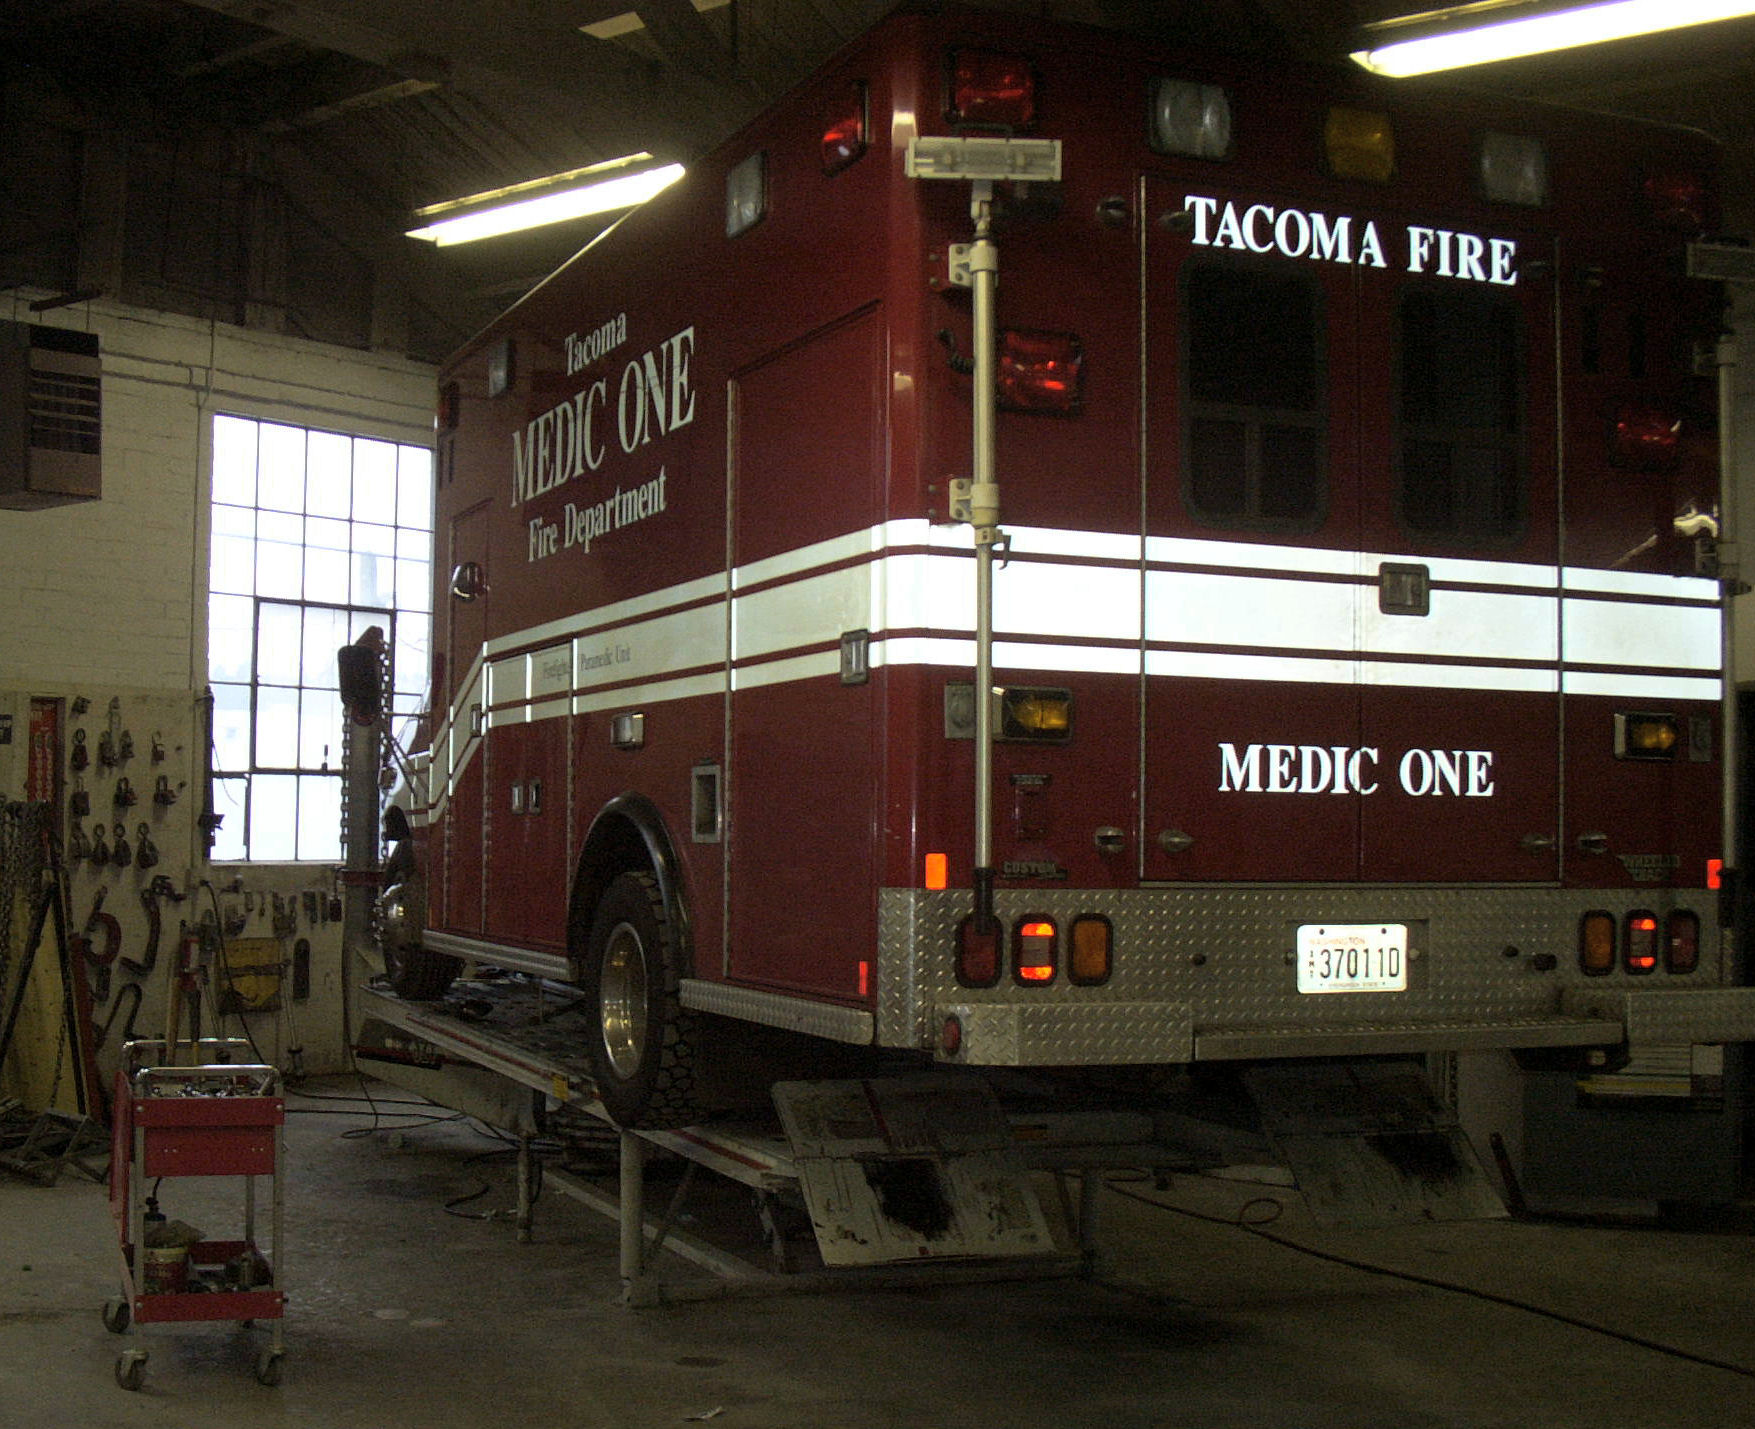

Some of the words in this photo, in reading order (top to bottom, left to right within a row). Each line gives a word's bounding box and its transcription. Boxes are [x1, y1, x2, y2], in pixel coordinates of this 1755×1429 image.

[1184, 195, 1387, 268] TACOMA
[1406, 225, 1518, 286] FIRE
[564, 312, 627, 376] Tacoma
[511, 377, 607, 508] MEDIC
[618, 326, 695, 453] ONE
[528, 516, 558, 562] Fire
[564, 464, 667, 554] Department
[1217, 743, 1379, 795] MEDIC
[1399, 748, 1494, 797] ONE
